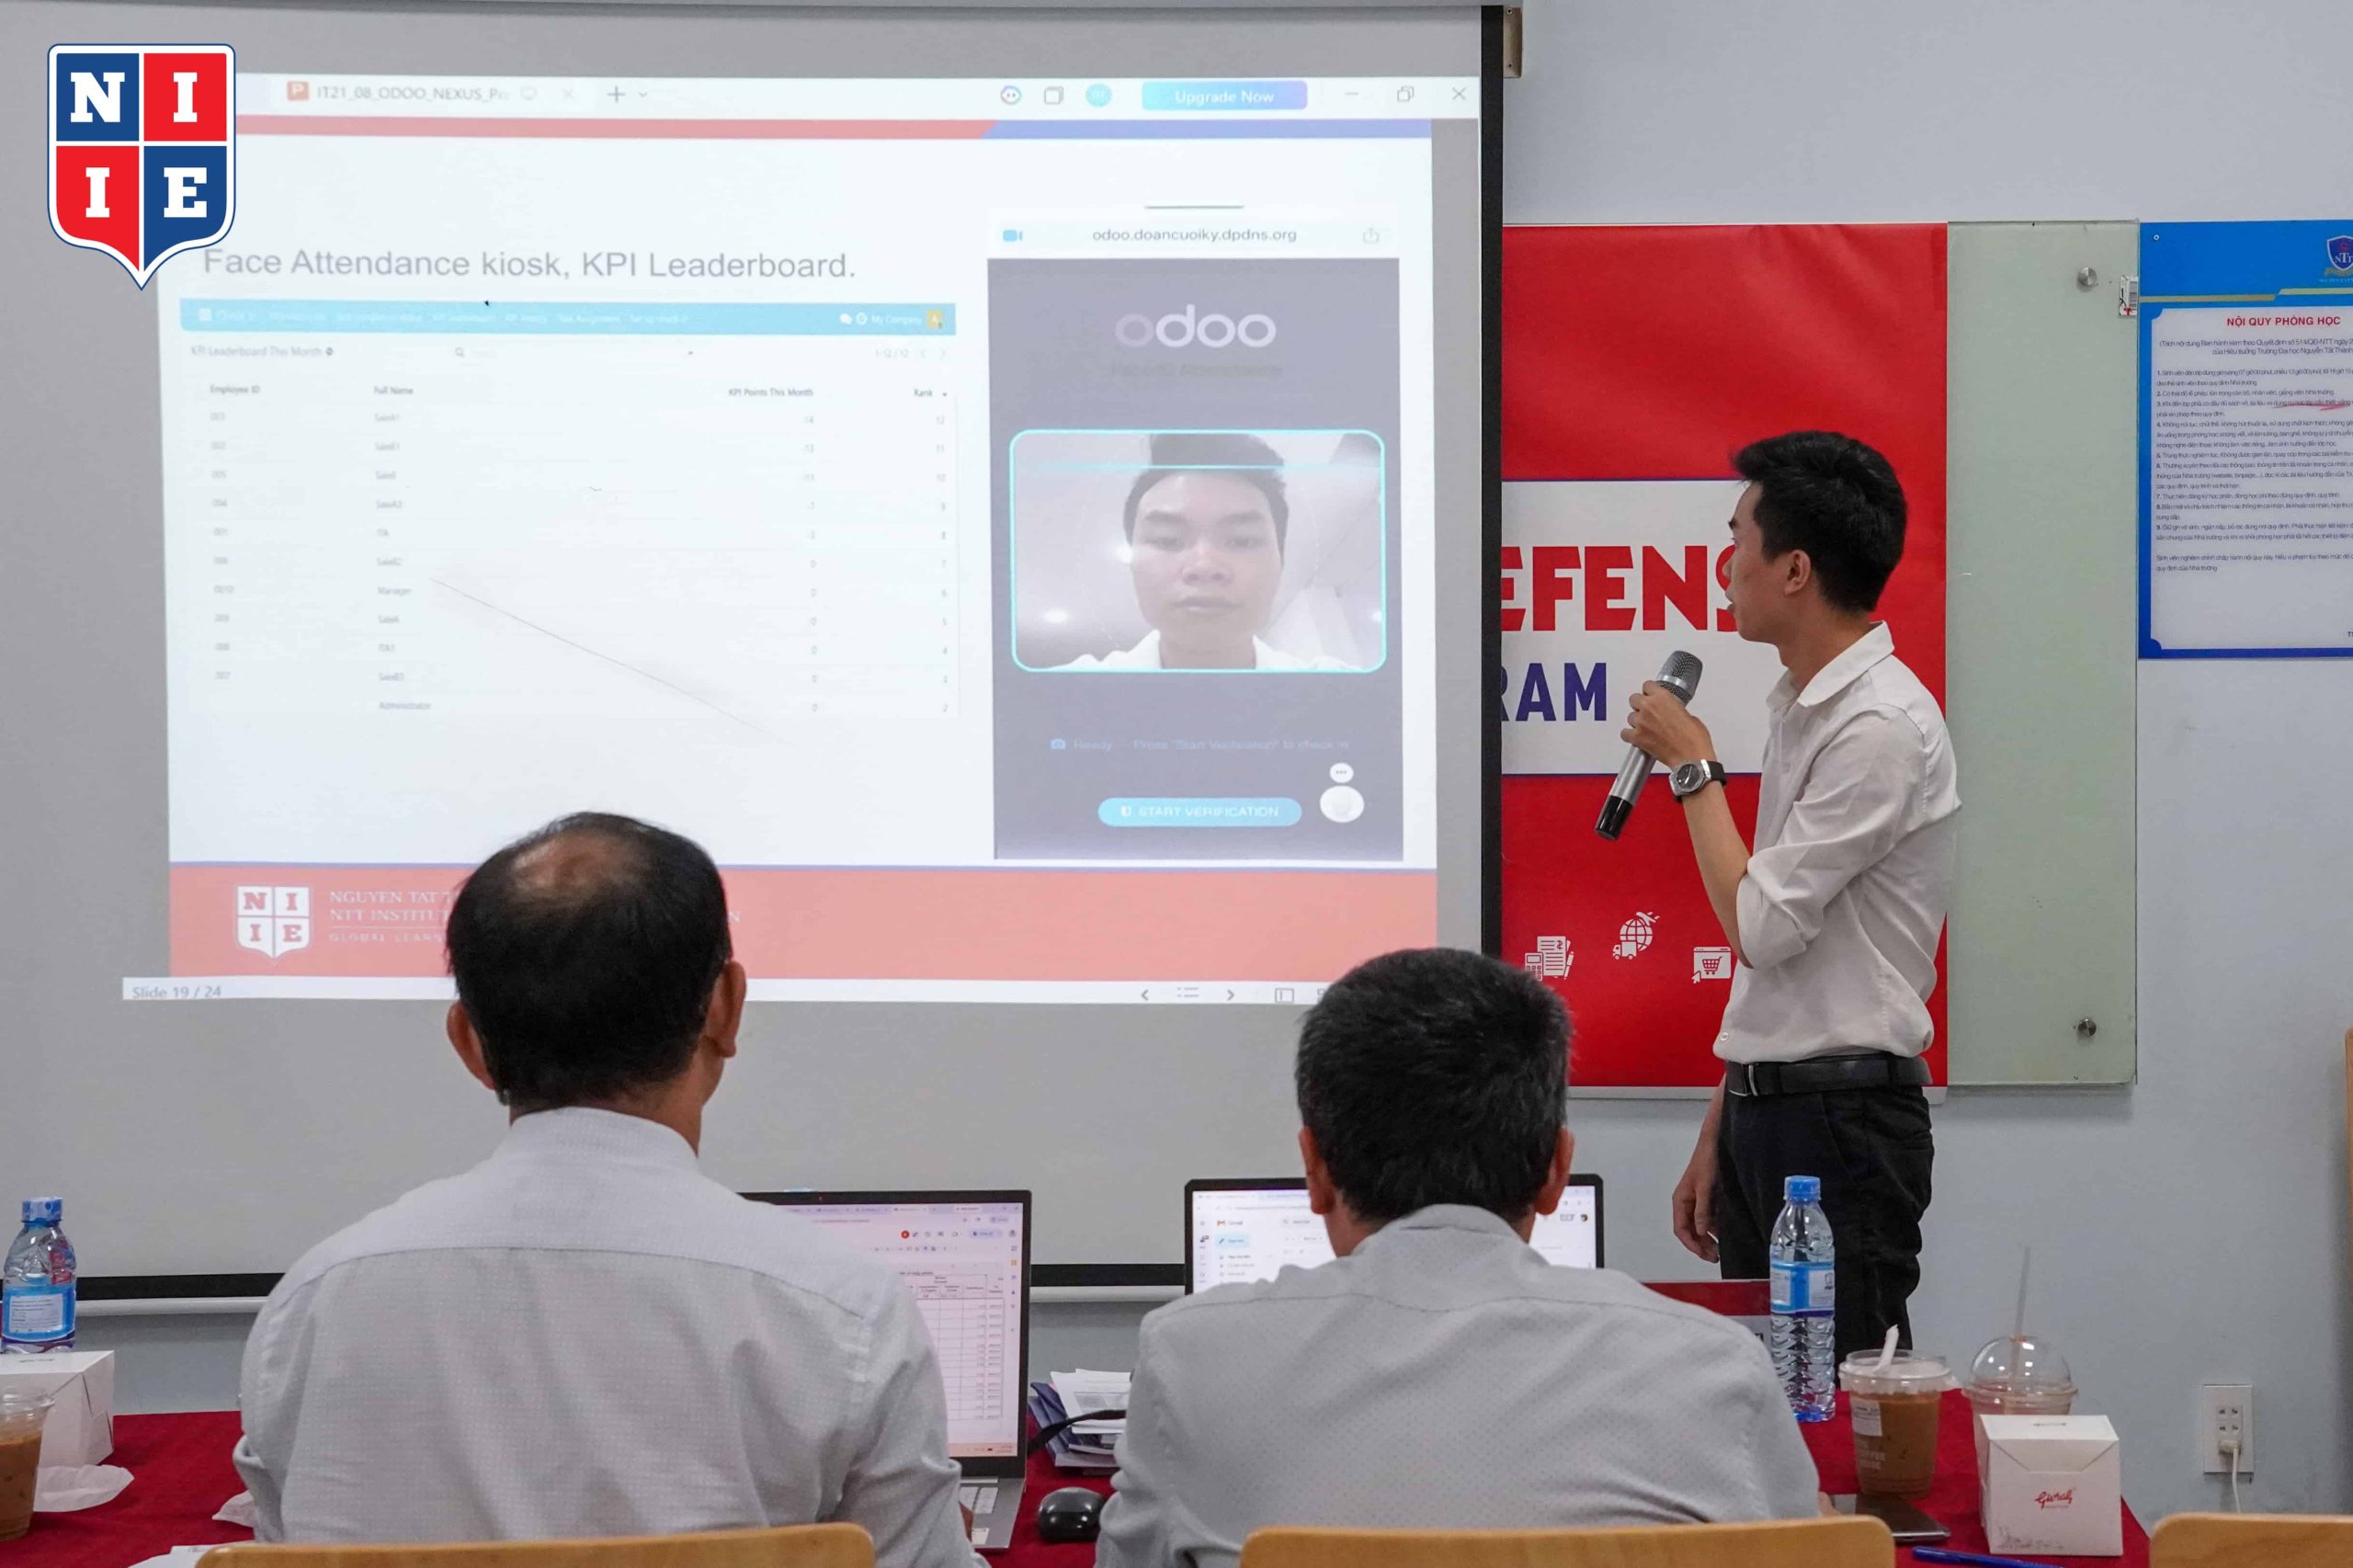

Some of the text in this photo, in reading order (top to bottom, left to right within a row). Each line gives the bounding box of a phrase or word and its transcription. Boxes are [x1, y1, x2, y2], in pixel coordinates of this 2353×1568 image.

[1176, 90, 1274, 106] Upgrade Now
[1093, 228, 1297, 242] odoo.doancuoiky.dpdns.org
[203, 248, 856, 278] Face Attendance kiosk, KPI Leaderboard.
[885, 315, 923, 326] Company
[1115, 303, 1277, 347] odoo
[2227, 315, 2340, 327] NỘI QUY PHÒNG HỌC
[208, 346, 267, 357] Leaderboard
[210, 383, 260, 396] Employee ID
[374, 384, 414, 395] Full Name
[728, 386, 813, 397] KPI Points This Month
[913, 386, 933, 398] Rank
[1501, 662, 1607, 722] AM
[1138, 805, 1279, 818] START VERIFICATION
[243, 892, 298, 910] N I
[329, 891, 403, 903] NGUYEN
[370, 909, 450, 922] INSTITUT
[249, 924, 302, 942] I E
[131, 985, 167, 998] Slide
[173, 985, 189, 997] 19
[204, 984, 222, 997] 24
